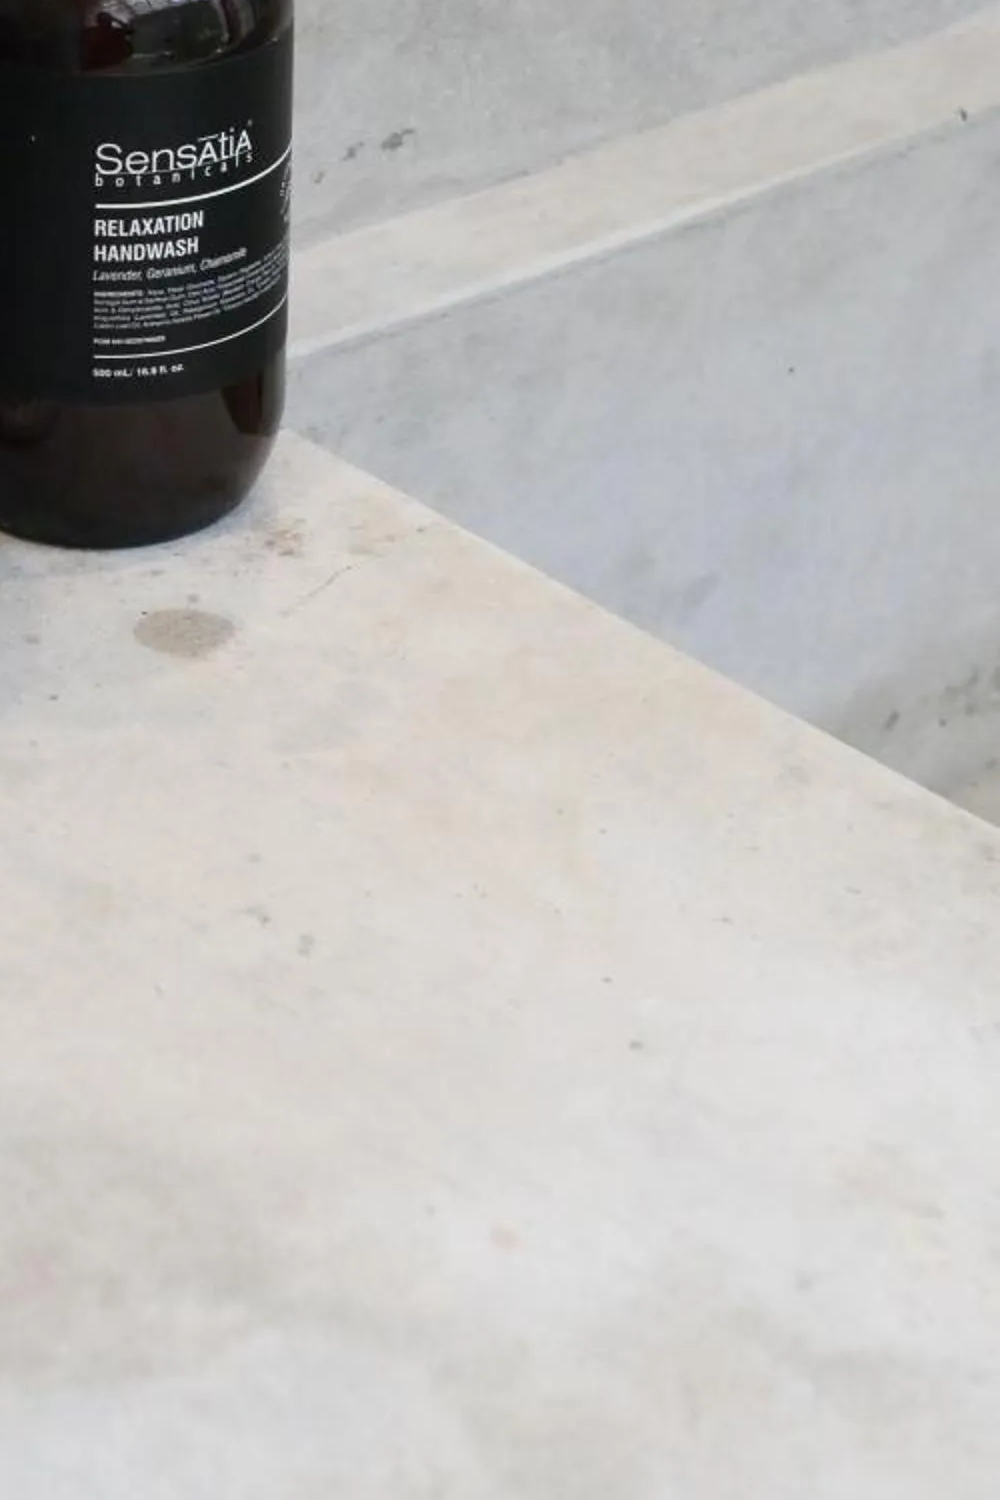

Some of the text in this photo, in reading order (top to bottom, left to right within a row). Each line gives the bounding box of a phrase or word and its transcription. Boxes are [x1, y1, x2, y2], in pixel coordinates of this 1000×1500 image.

[95, 150, 253, 187] botanicals
[94, 210, 204, 237] RELAXATION
[94, 236, 199, 262] HANDWASH
